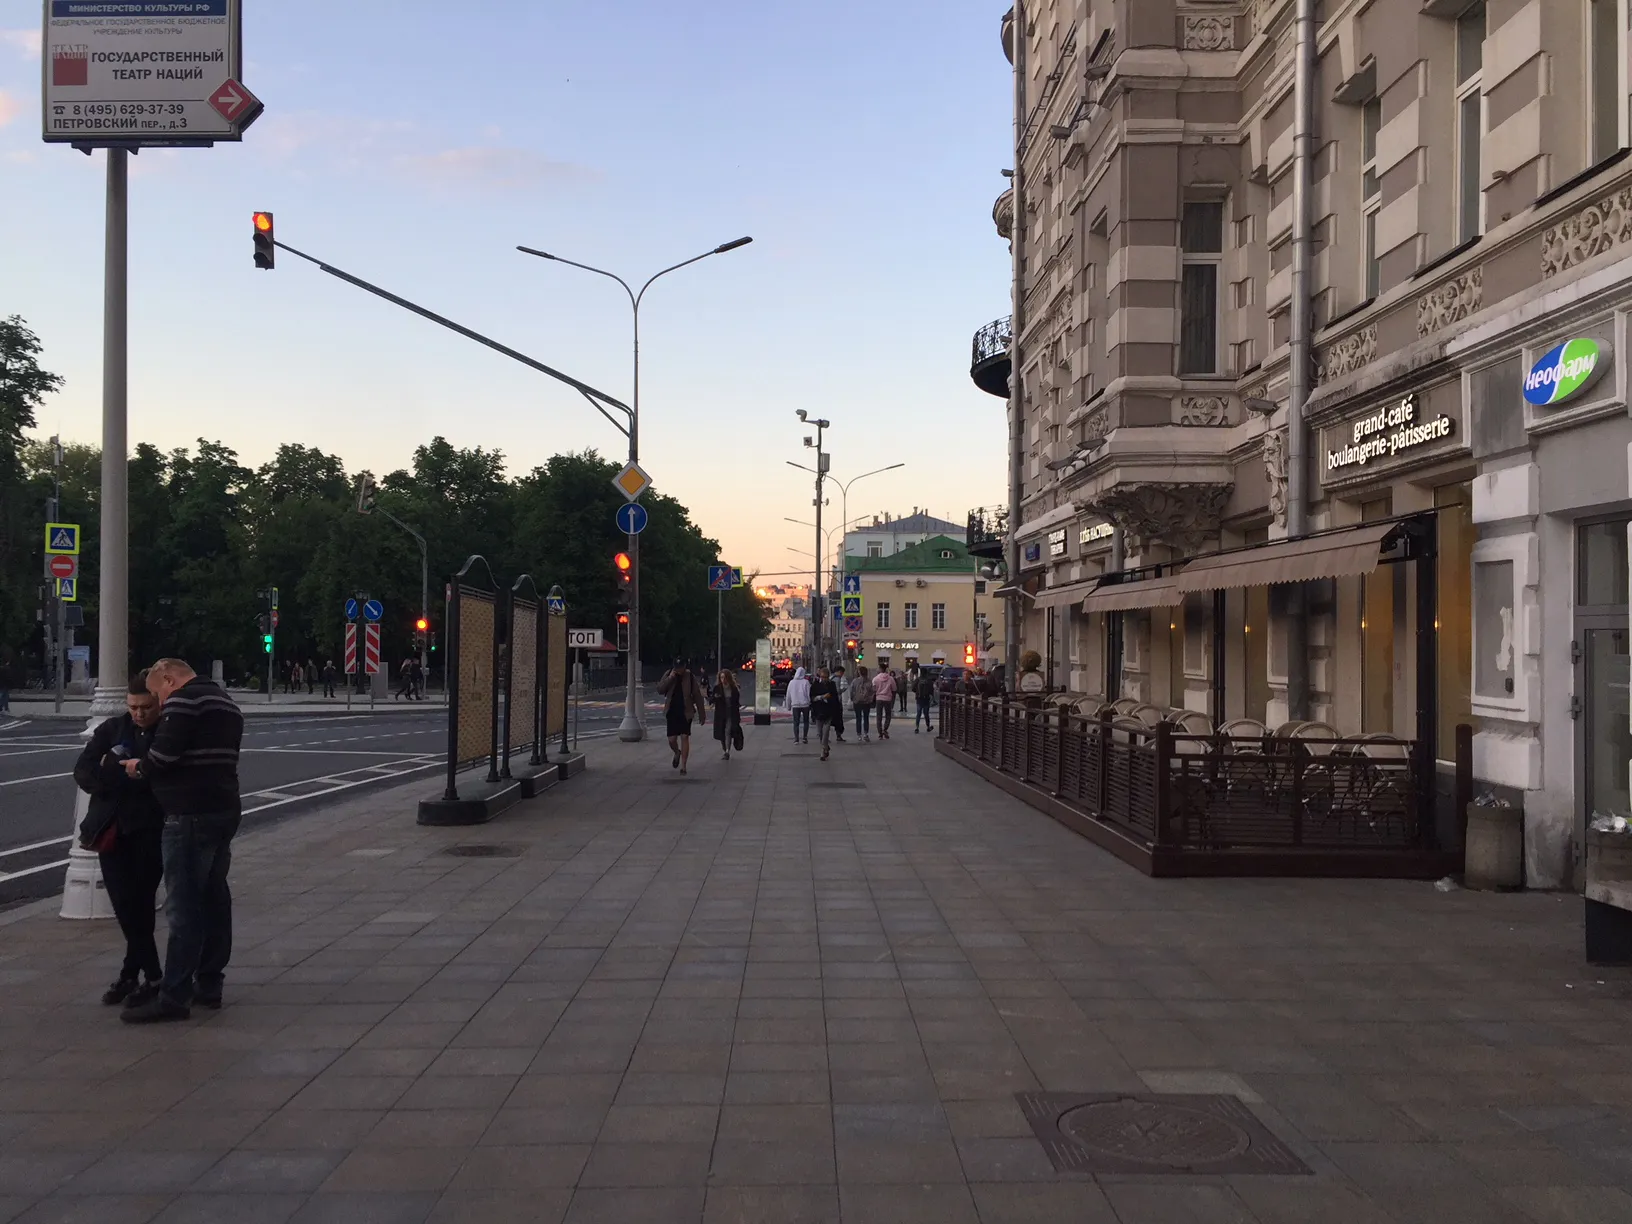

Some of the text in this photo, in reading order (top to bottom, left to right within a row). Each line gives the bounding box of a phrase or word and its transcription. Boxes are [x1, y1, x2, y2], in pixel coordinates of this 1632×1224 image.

[69, 4, 142, 12] МИНИСТЕРСТВО
[144, 4, 193, 12] КУЛЬТУРЫ
[93, 28, 143, 36] УЧРЕЖДЕНИЕ
[91, 49, 224, 64] ГОСУДАРСТВЕННЫЙ
[112, 66, 203, 81] ТЕАТР НАЦИЙ
[73, 104, 184, 116] 8 (495) 629-37-39
[53, 116, 138, 129] ПЕТРОВСКИЙ
[1328, 414, 1450, 470] boulangerie-pâtisserie
